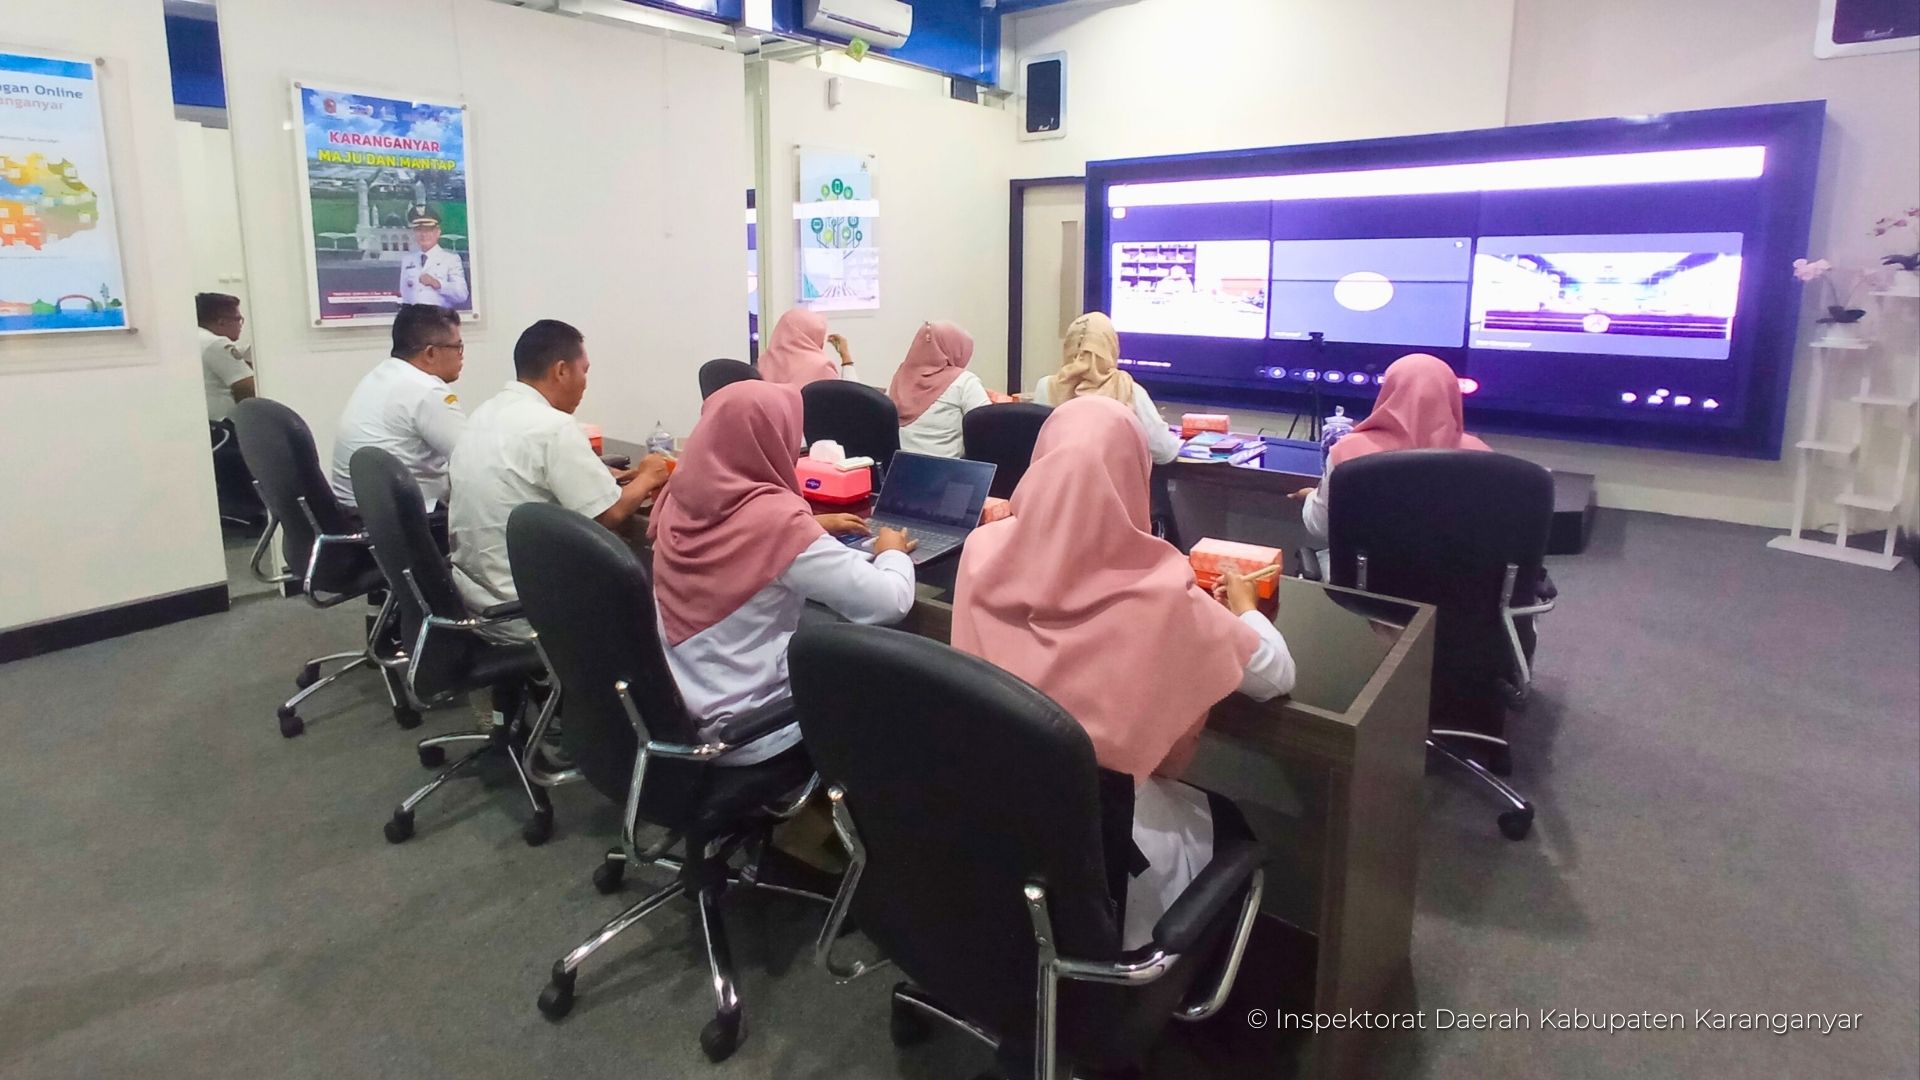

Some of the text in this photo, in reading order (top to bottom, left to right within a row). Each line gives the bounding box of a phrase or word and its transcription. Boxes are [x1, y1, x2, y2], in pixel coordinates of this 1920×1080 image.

[0, 83, 83, 99] gan Online
[329, 131, 441, 153] KARANGANYAR
[319, 149, 456, 171] MAJU DAN MANTAP
